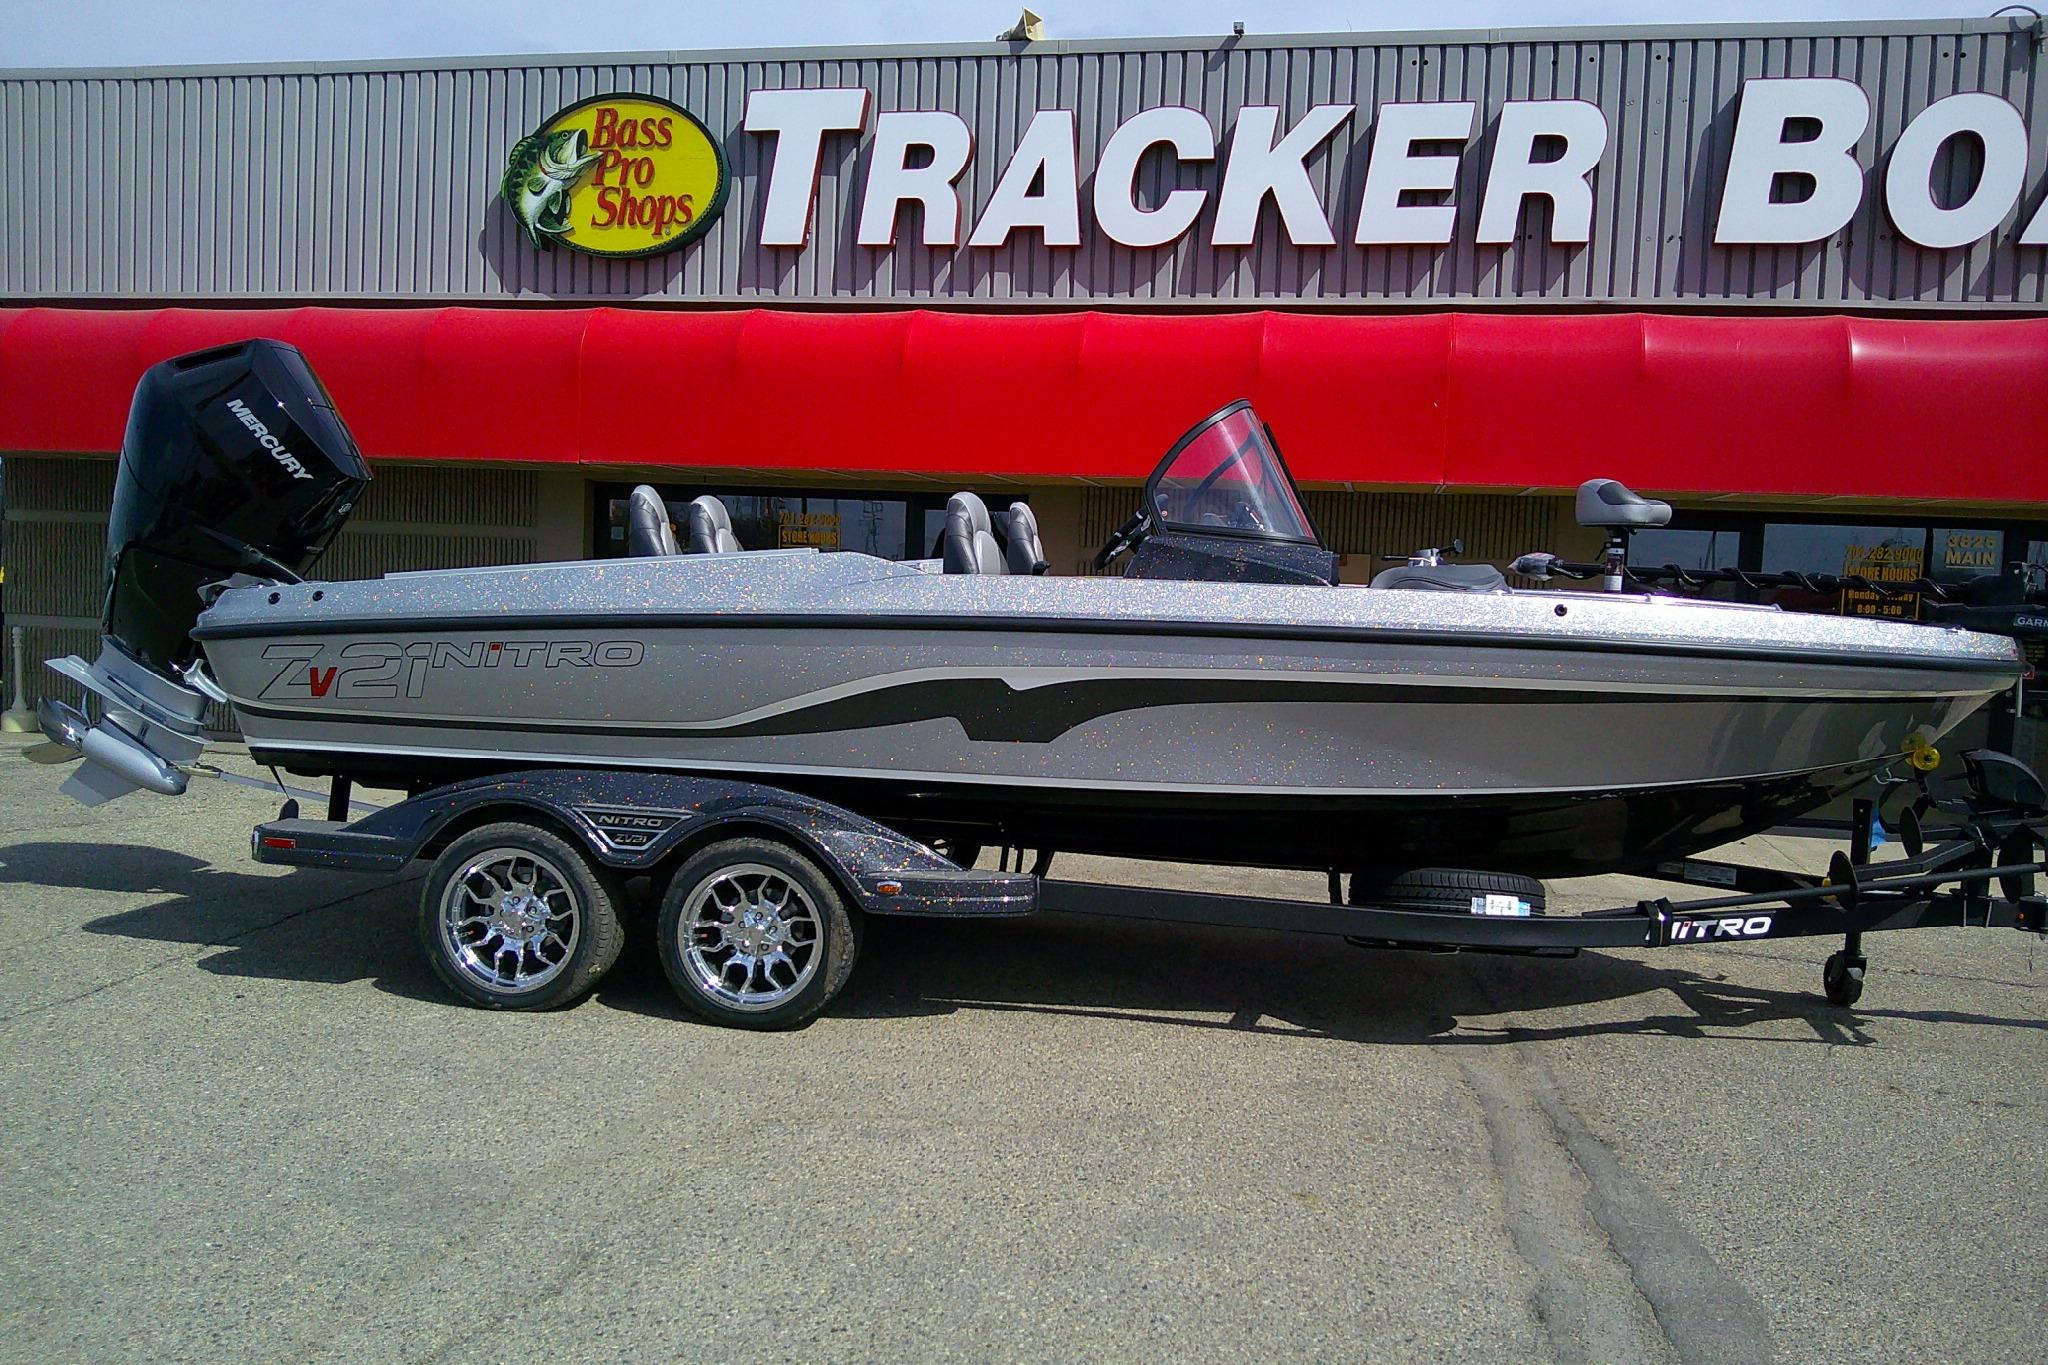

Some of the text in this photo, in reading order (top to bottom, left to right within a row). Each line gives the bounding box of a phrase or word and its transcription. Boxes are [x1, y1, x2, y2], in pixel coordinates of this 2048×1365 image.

[589, 107, 673, 150] Bass
[591, 149, 656, 187] Pro
[743, 76, 2048, 249] TRACKER BO
[591, 186, 695, 238] Shops
[226, 398, 314, 480] MERCURY
[1945, 550, 1997, 566] MAIN
[1946, 534, 1997, 548] 3825
[1882, 567, 1917, 581] HOURS
